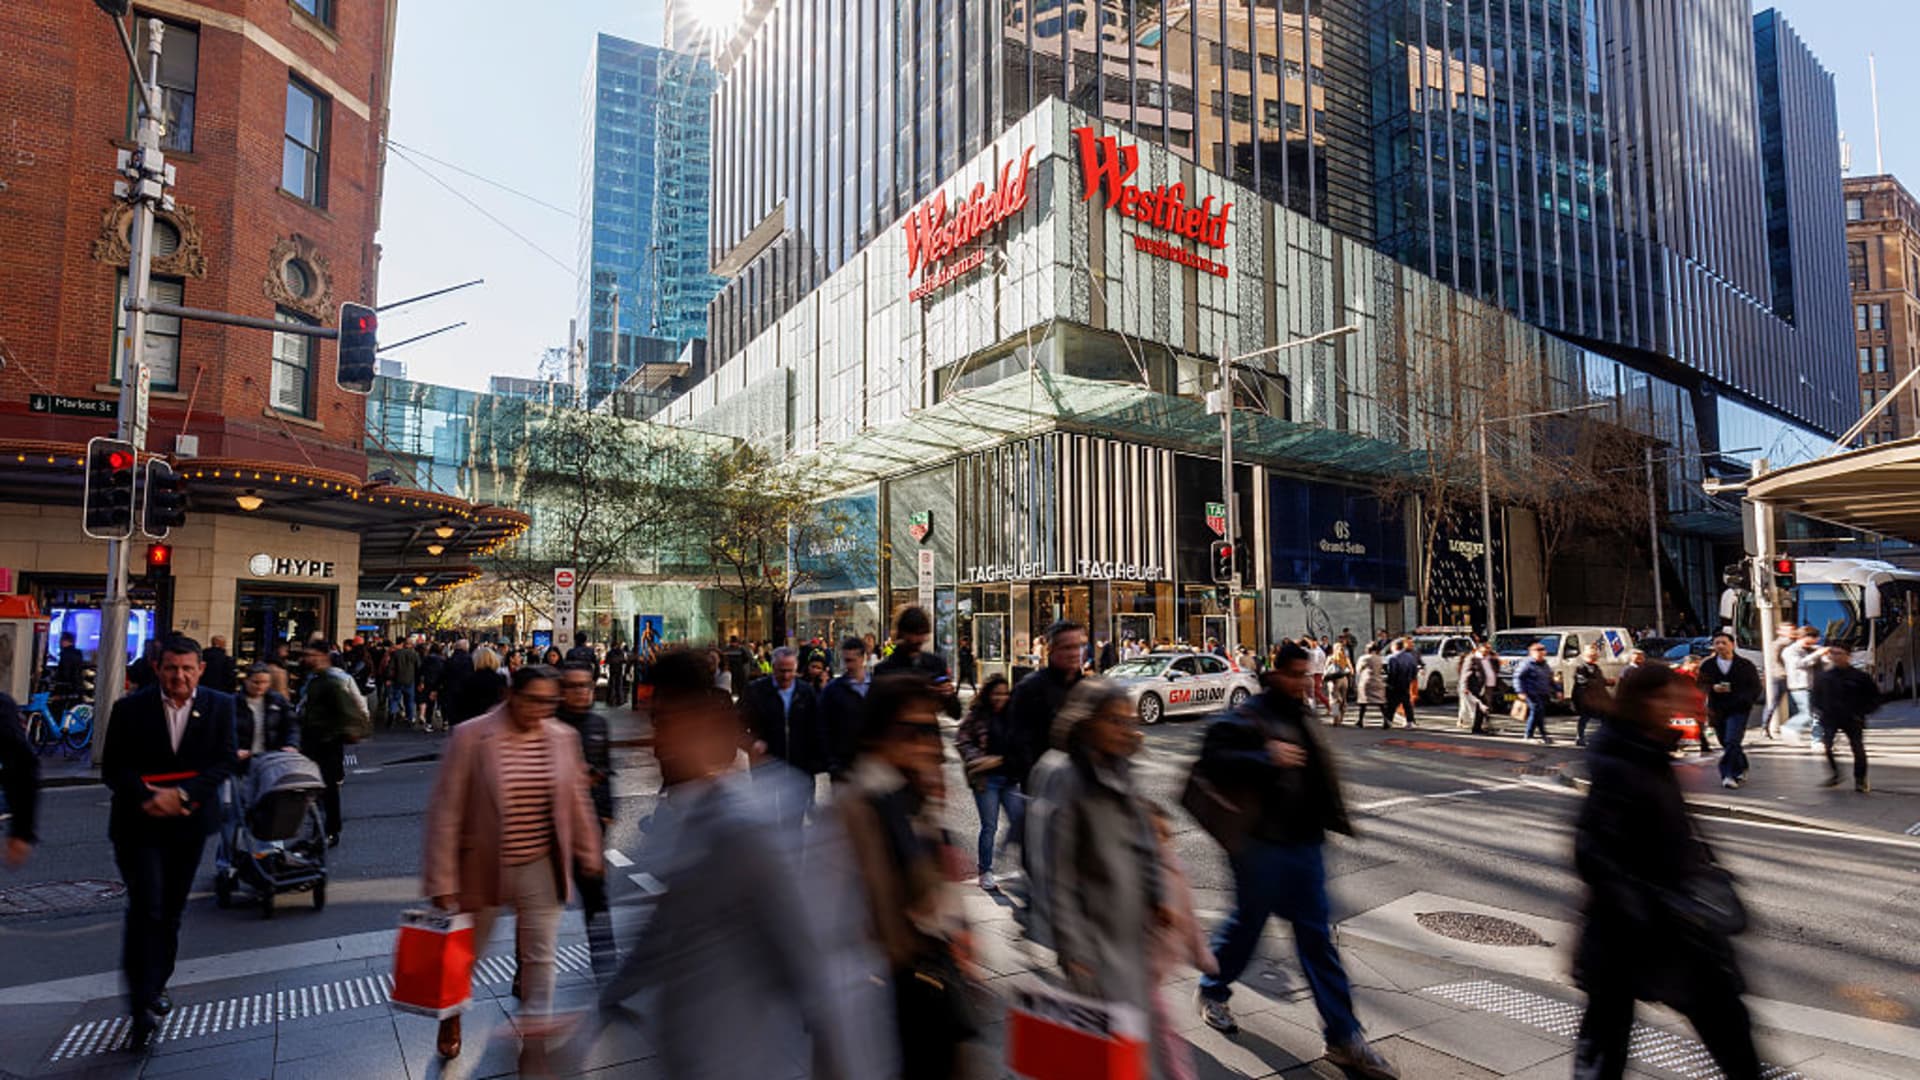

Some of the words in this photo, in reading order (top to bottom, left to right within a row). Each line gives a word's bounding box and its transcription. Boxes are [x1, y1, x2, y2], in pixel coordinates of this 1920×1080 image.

[1071, 127, 1234, 249] Westfield
[903, 144, 1036, 279] Westfield
[55, 397, 96, 411] Market
[98, 402, 112, 412] St
[272, 557, 335, 578] HYPE
[1169, 688, 1191, 704] GM
